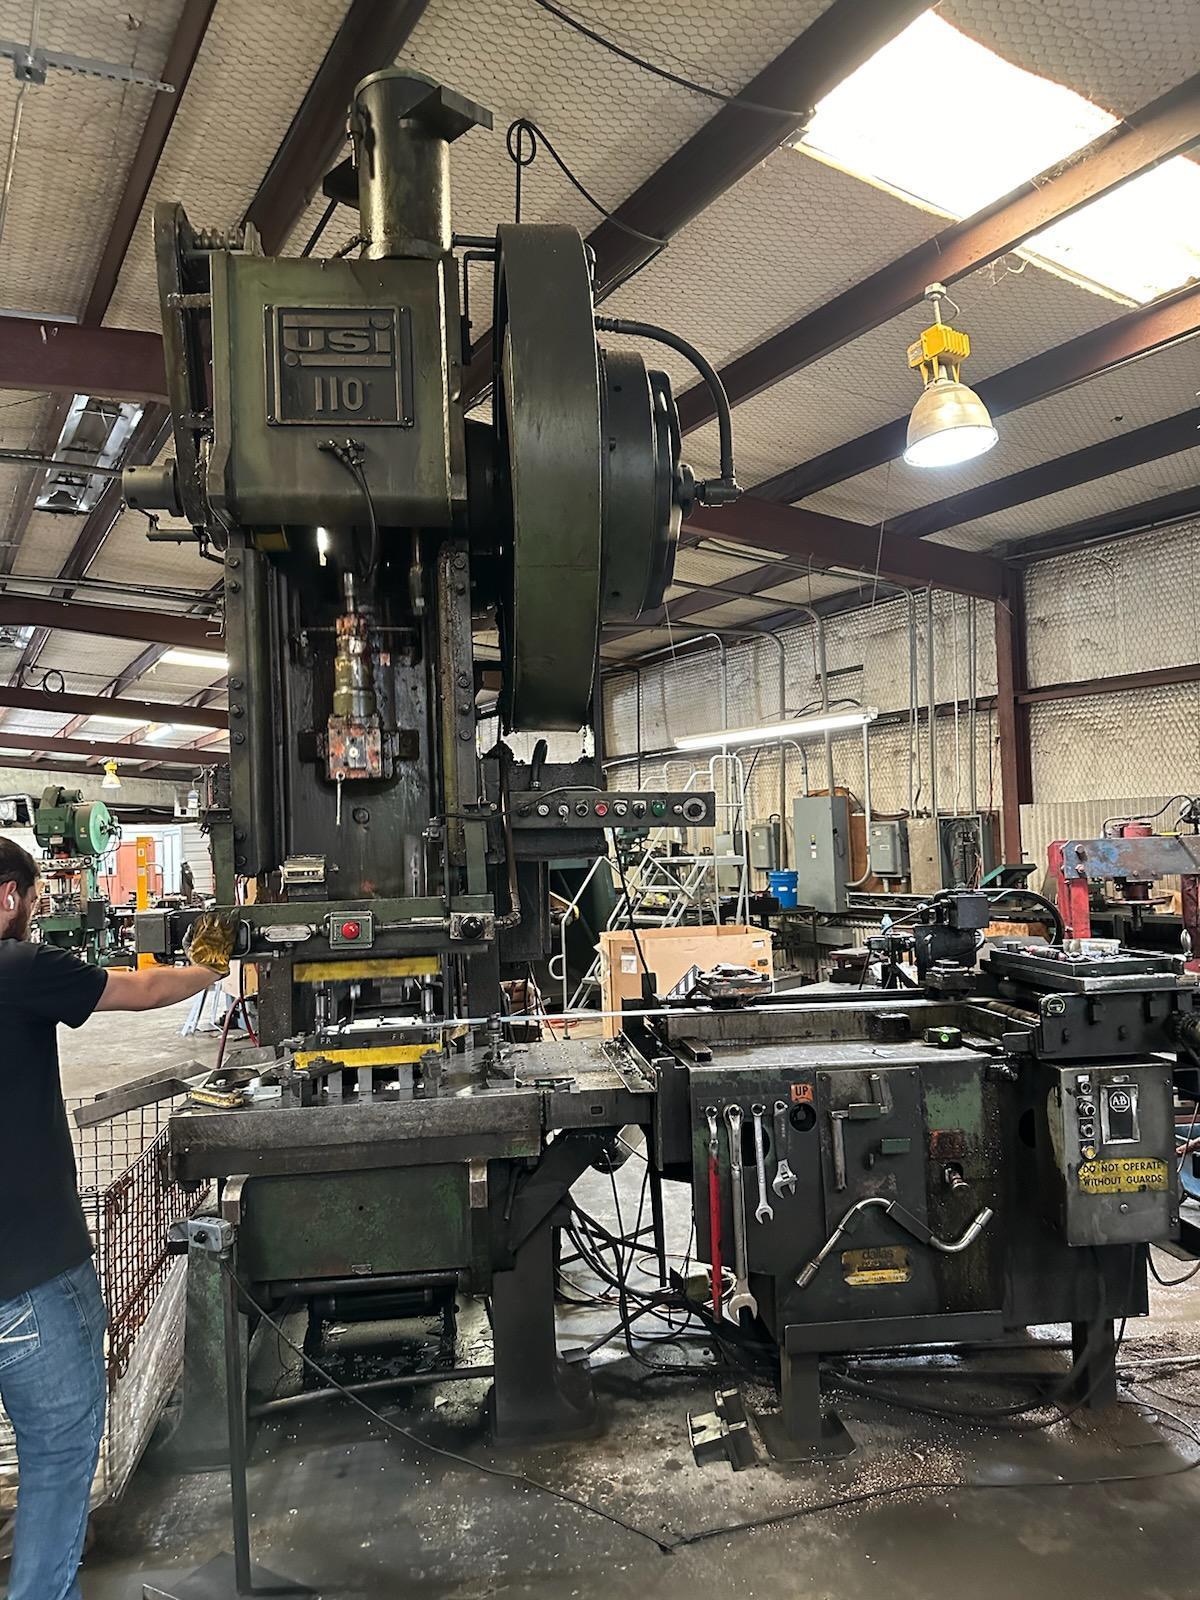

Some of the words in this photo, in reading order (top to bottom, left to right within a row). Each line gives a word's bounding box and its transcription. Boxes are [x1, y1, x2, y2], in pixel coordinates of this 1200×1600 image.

[314, 376, 364, 411] 110
[795, 1085, 808, 1096] UP
[1083, 1165, 1096, 1173] DO
[1101, 1163, 1119, 1172] NOT
[1123, 1161, 1162, 1171] OPERATE
[1084, 1176, 1122, 1186] WITHOUT
[1126, 1175, 1162, 1184] GUARDS
